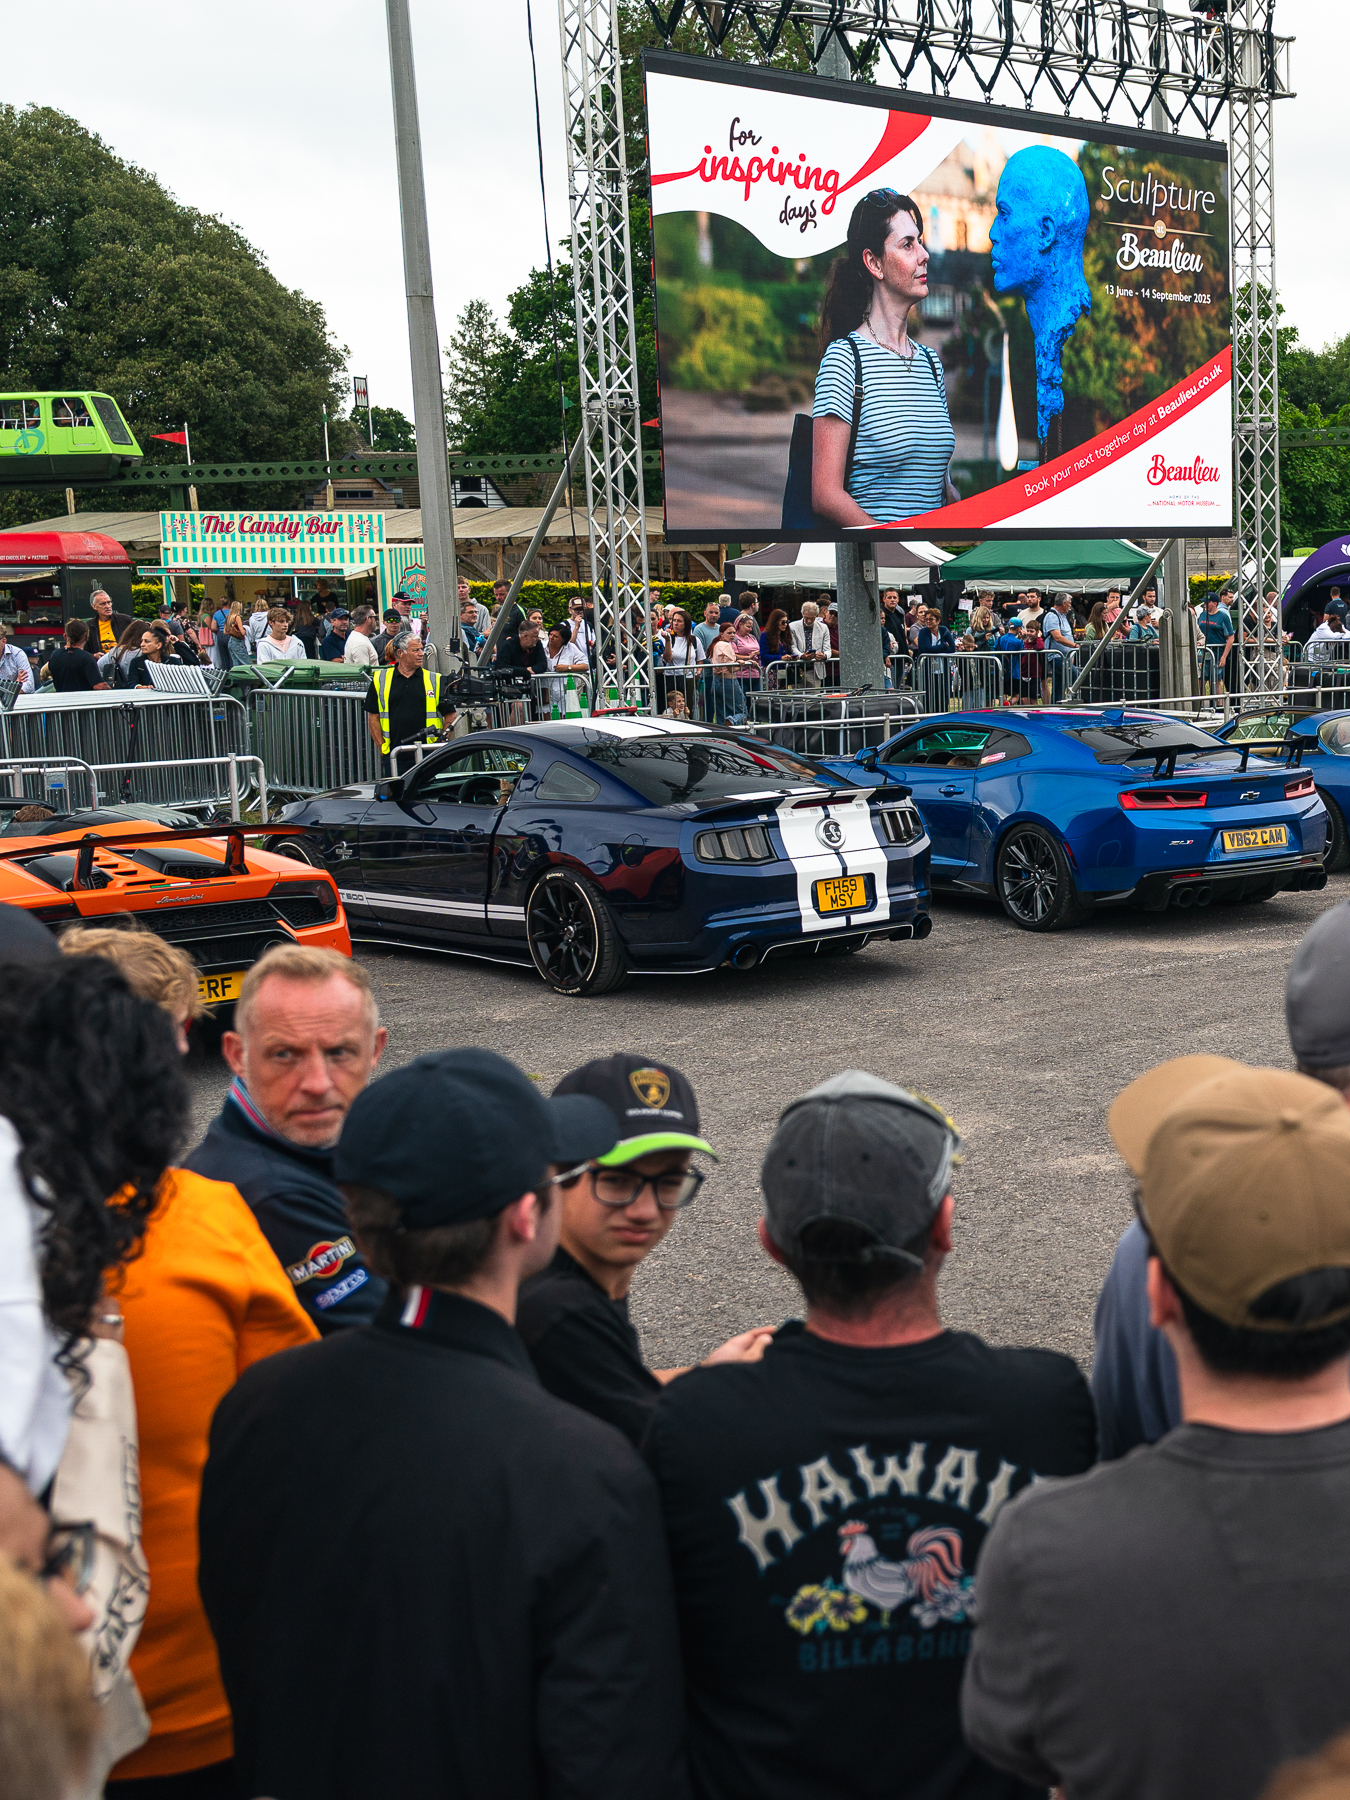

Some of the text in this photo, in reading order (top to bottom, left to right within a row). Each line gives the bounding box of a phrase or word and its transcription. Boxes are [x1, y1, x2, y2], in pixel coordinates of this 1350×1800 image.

[729, 117, 762, 152] for
[699, 145, 840, 215] inspiring
[1100, 166, 1216, 216] Sculpture
[779, 195, 817, 233] days
[1156, 225, 1164, 234] at
[1116, 232, 1204, 274] Beaulieu
[1105, 284, 1115, 295] 13
[1116, 285, 1134, 298] June
[1141, 288, 1151, 299] 14
[1152, 289, 1192, 303] September
[1194, 293, 1211, 304] 2025
[1024, 363, 1223, 497] Book your next together day at Beaulieu.co.uk
[1147, 454, 1220, 486] Beaulieu
[201, 514, 343, 541] The Candy Bar
[91, 578, 103, 590] The
[1228, 828, 1284, 848] VB62 CAM
[824, 878, 858, 896] FH59
[830, 893, 854, 908] MSY
[290, 1239, 354, 1283] MARTINI
[727, 1441, 1055, 1571] HAWAI
